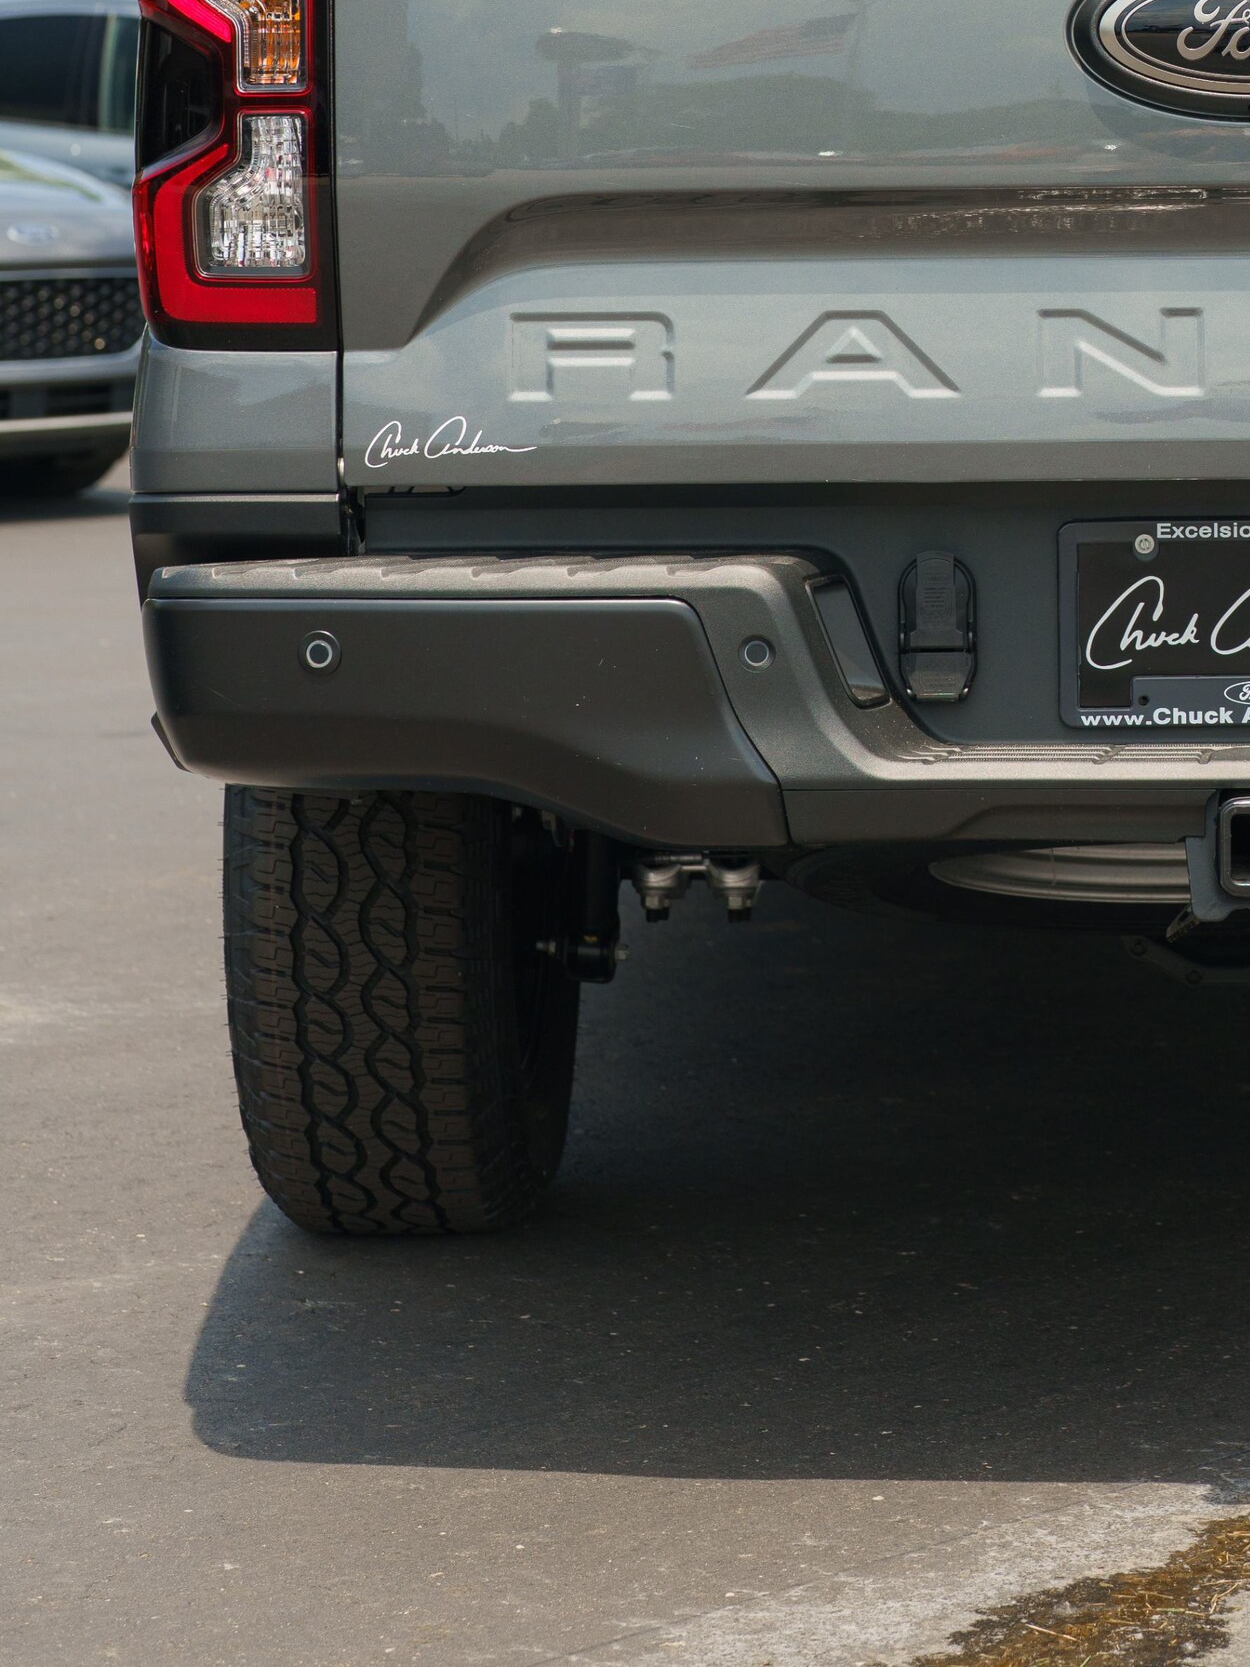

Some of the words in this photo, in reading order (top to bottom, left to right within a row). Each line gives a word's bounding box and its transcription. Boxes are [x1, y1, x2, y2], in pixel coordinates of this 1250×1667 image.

[365, 420, 420, 468] Chuck
[424, 416, 537, 459] Anderson
[1086, 575, 1199, 670] Chuck
